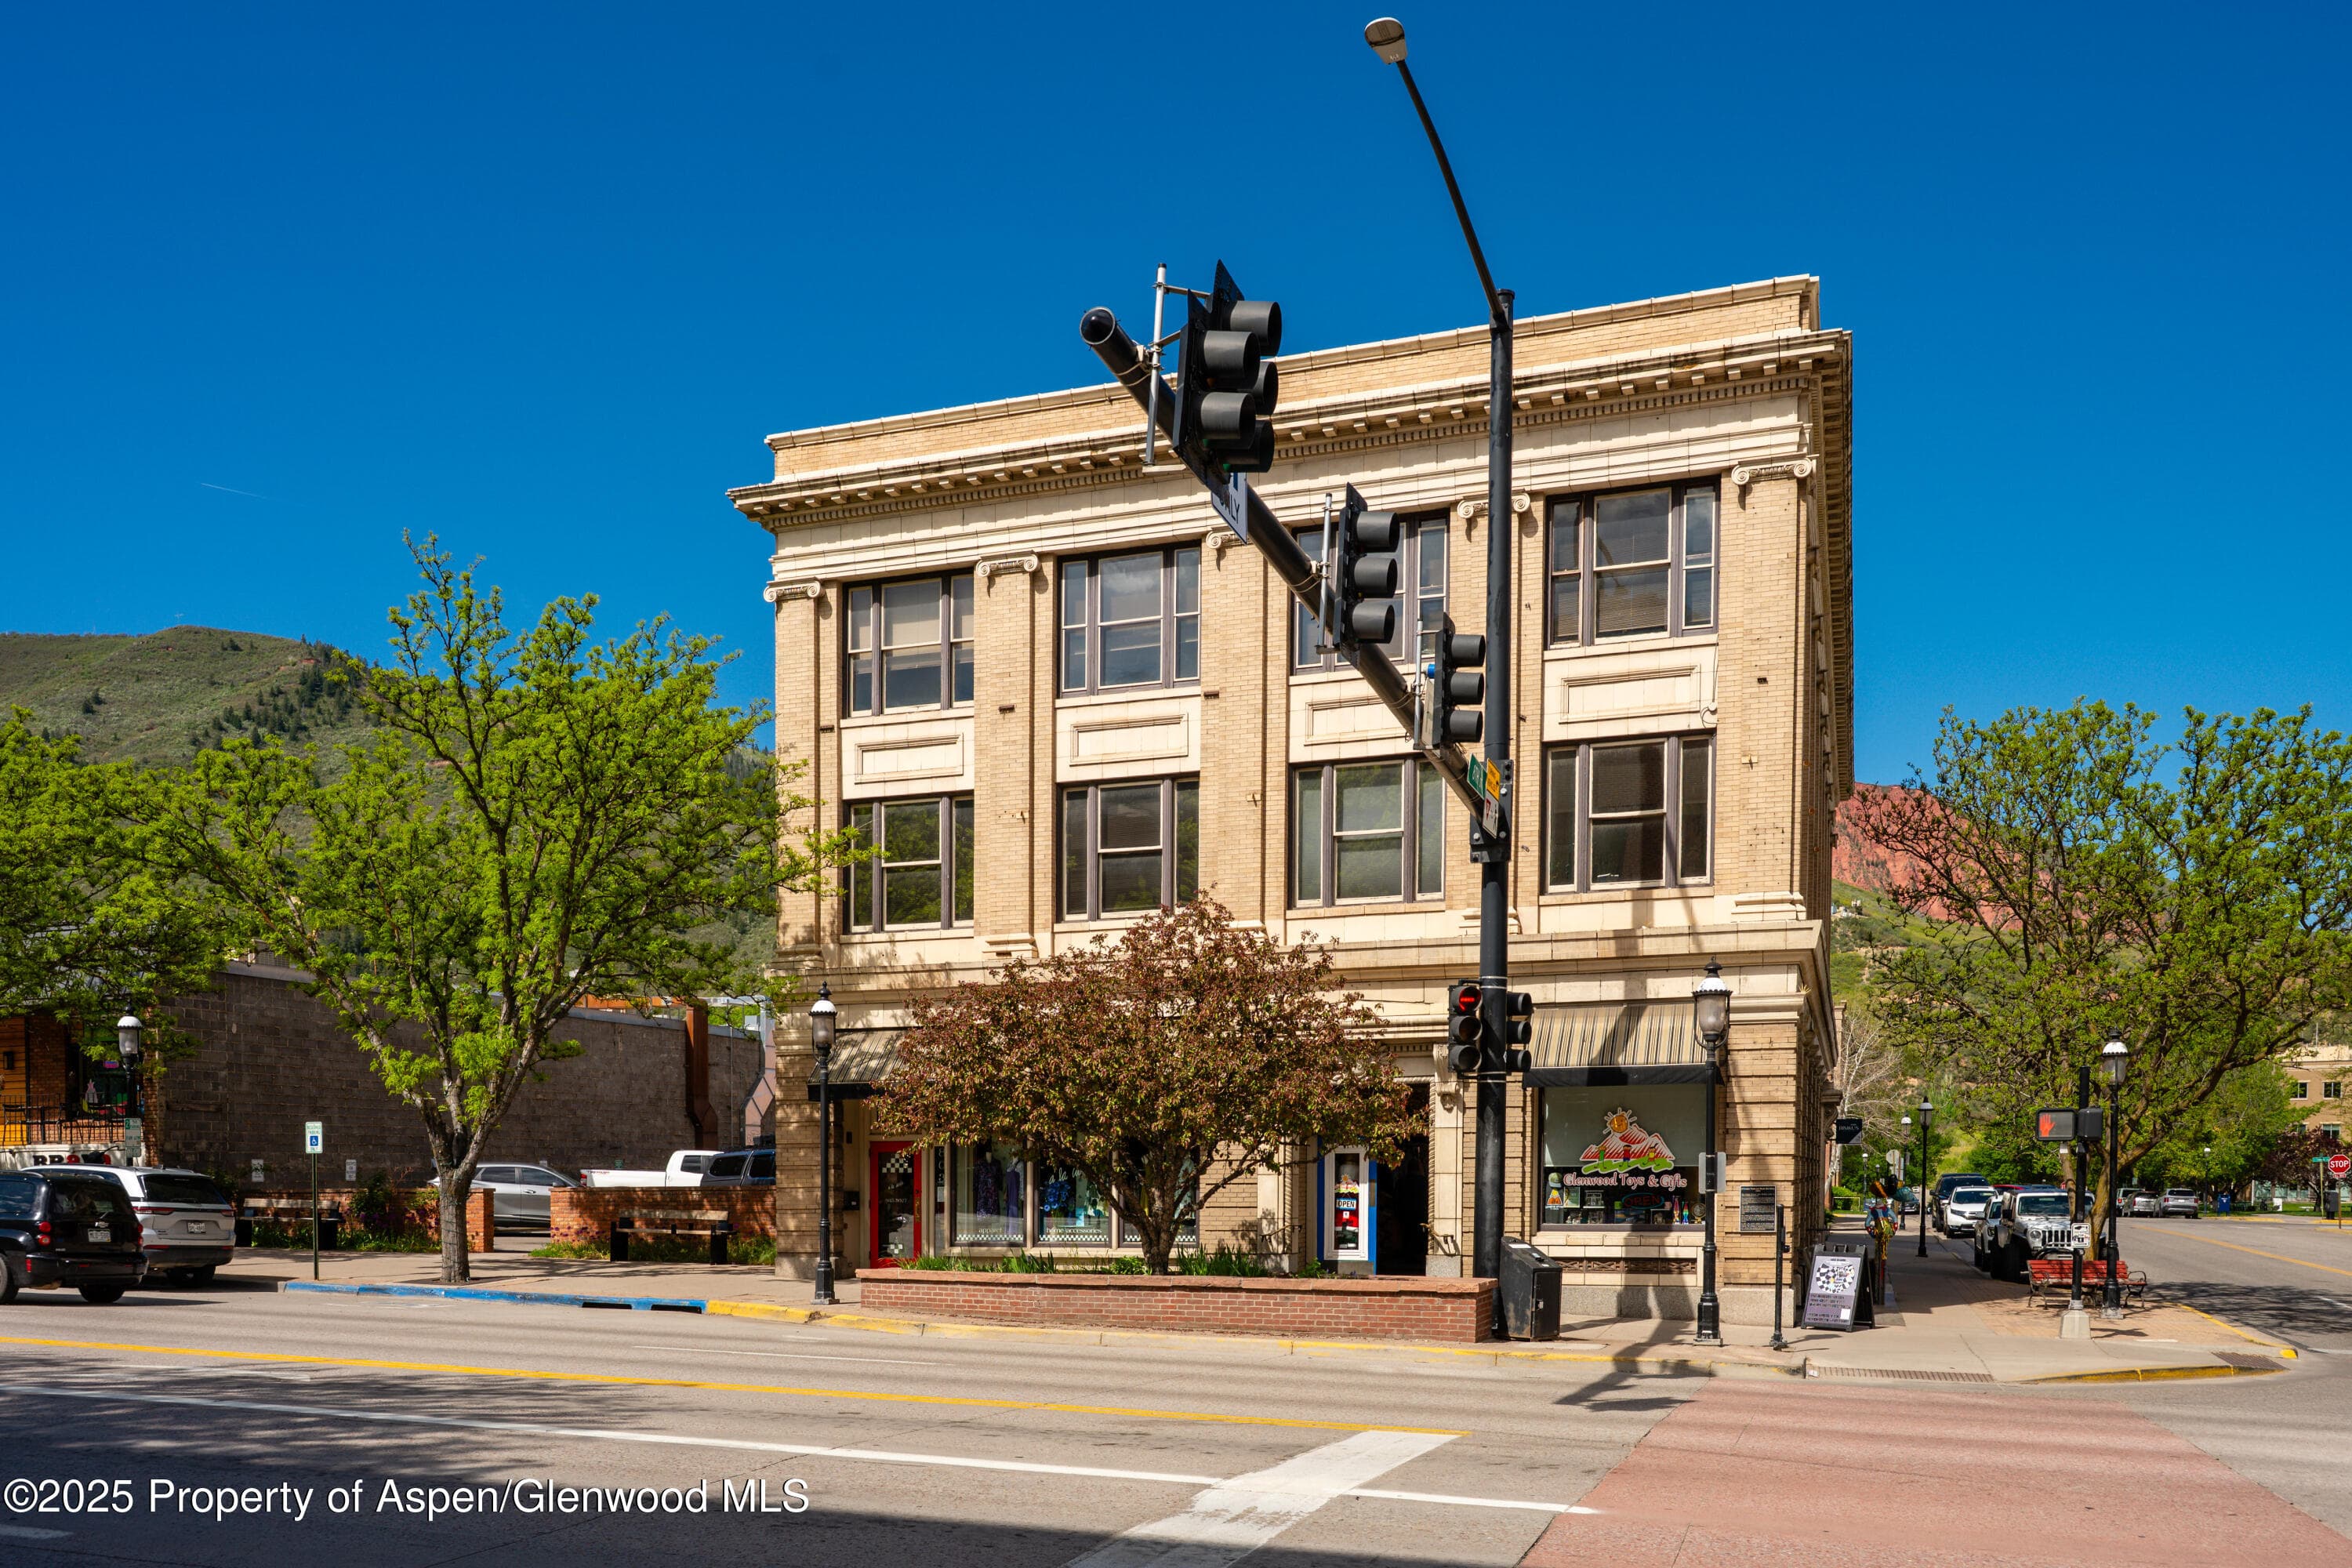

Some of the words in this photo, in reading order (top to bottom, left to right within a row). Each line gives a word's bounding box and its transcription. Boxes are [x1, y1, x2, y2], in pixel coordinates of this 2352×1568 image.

[1563, 1172, 1617, 1186] Glenwood
[1619, 1173, 1645, 1189] Toys
[1647, 1175, 1658, 1187] &
[1660, 1173, 1687, 1191] Gifts
[1624, 1194, 1661, 1207] OPEN
